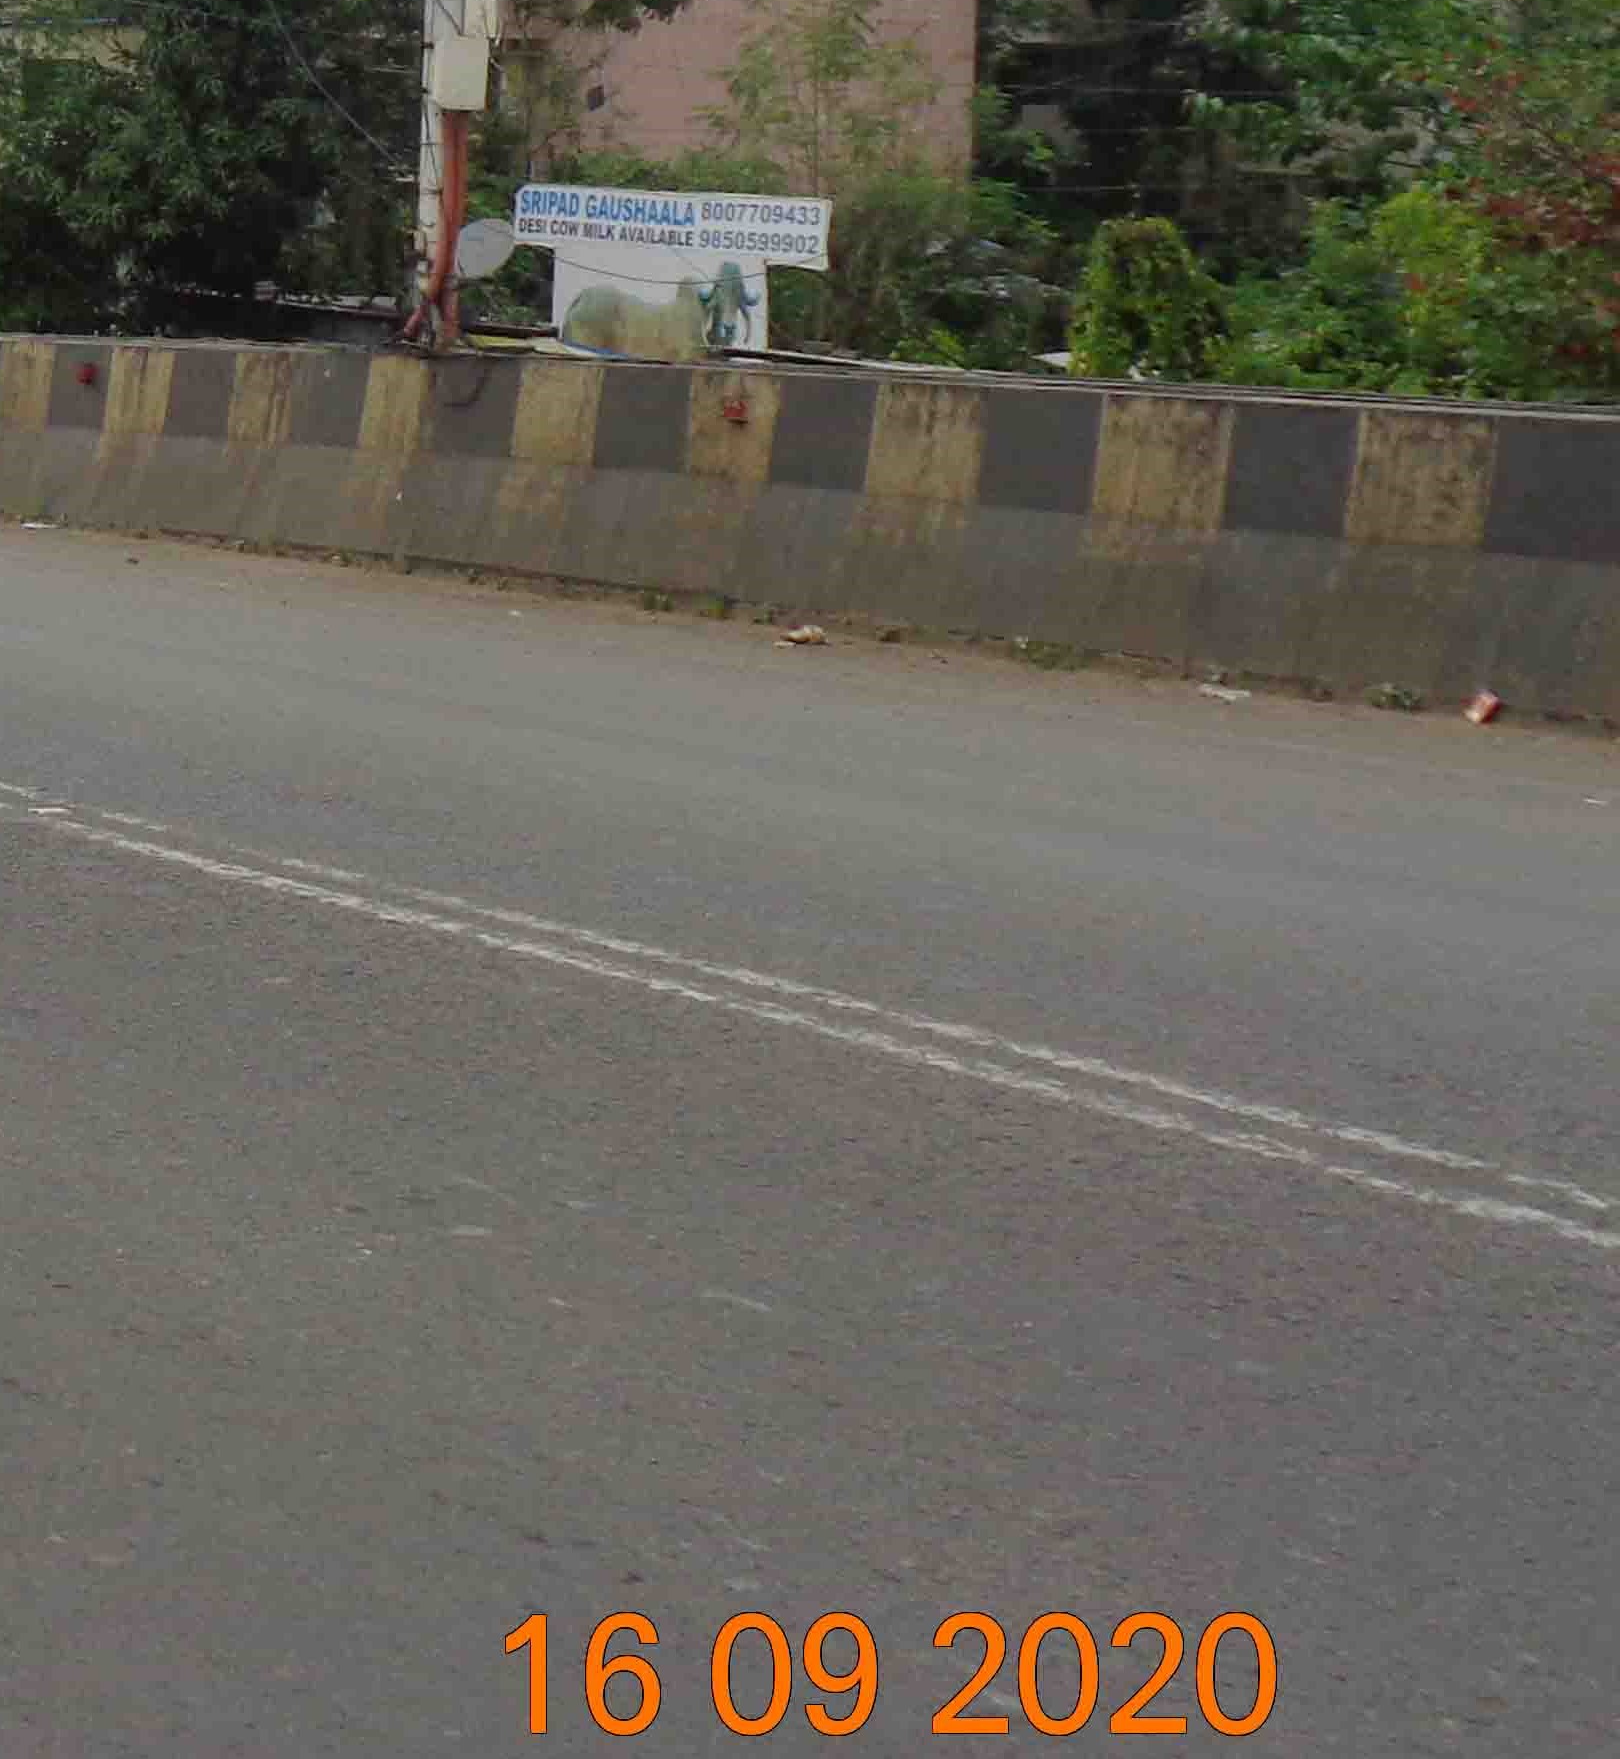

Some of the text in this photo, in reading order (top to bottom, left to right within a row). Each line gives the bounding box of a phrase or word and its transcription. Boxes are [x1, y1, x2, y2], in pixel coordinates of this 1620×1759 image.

[520, 191, 821, 225] SRIPAD GAUSHAALA 8007709433
[518, 218, 547, 233] DESI
[550, 220, 578, 236] COW
[581, 222, 615, 240] MILK
[619, 225, 693, 247] AVAILABLE
